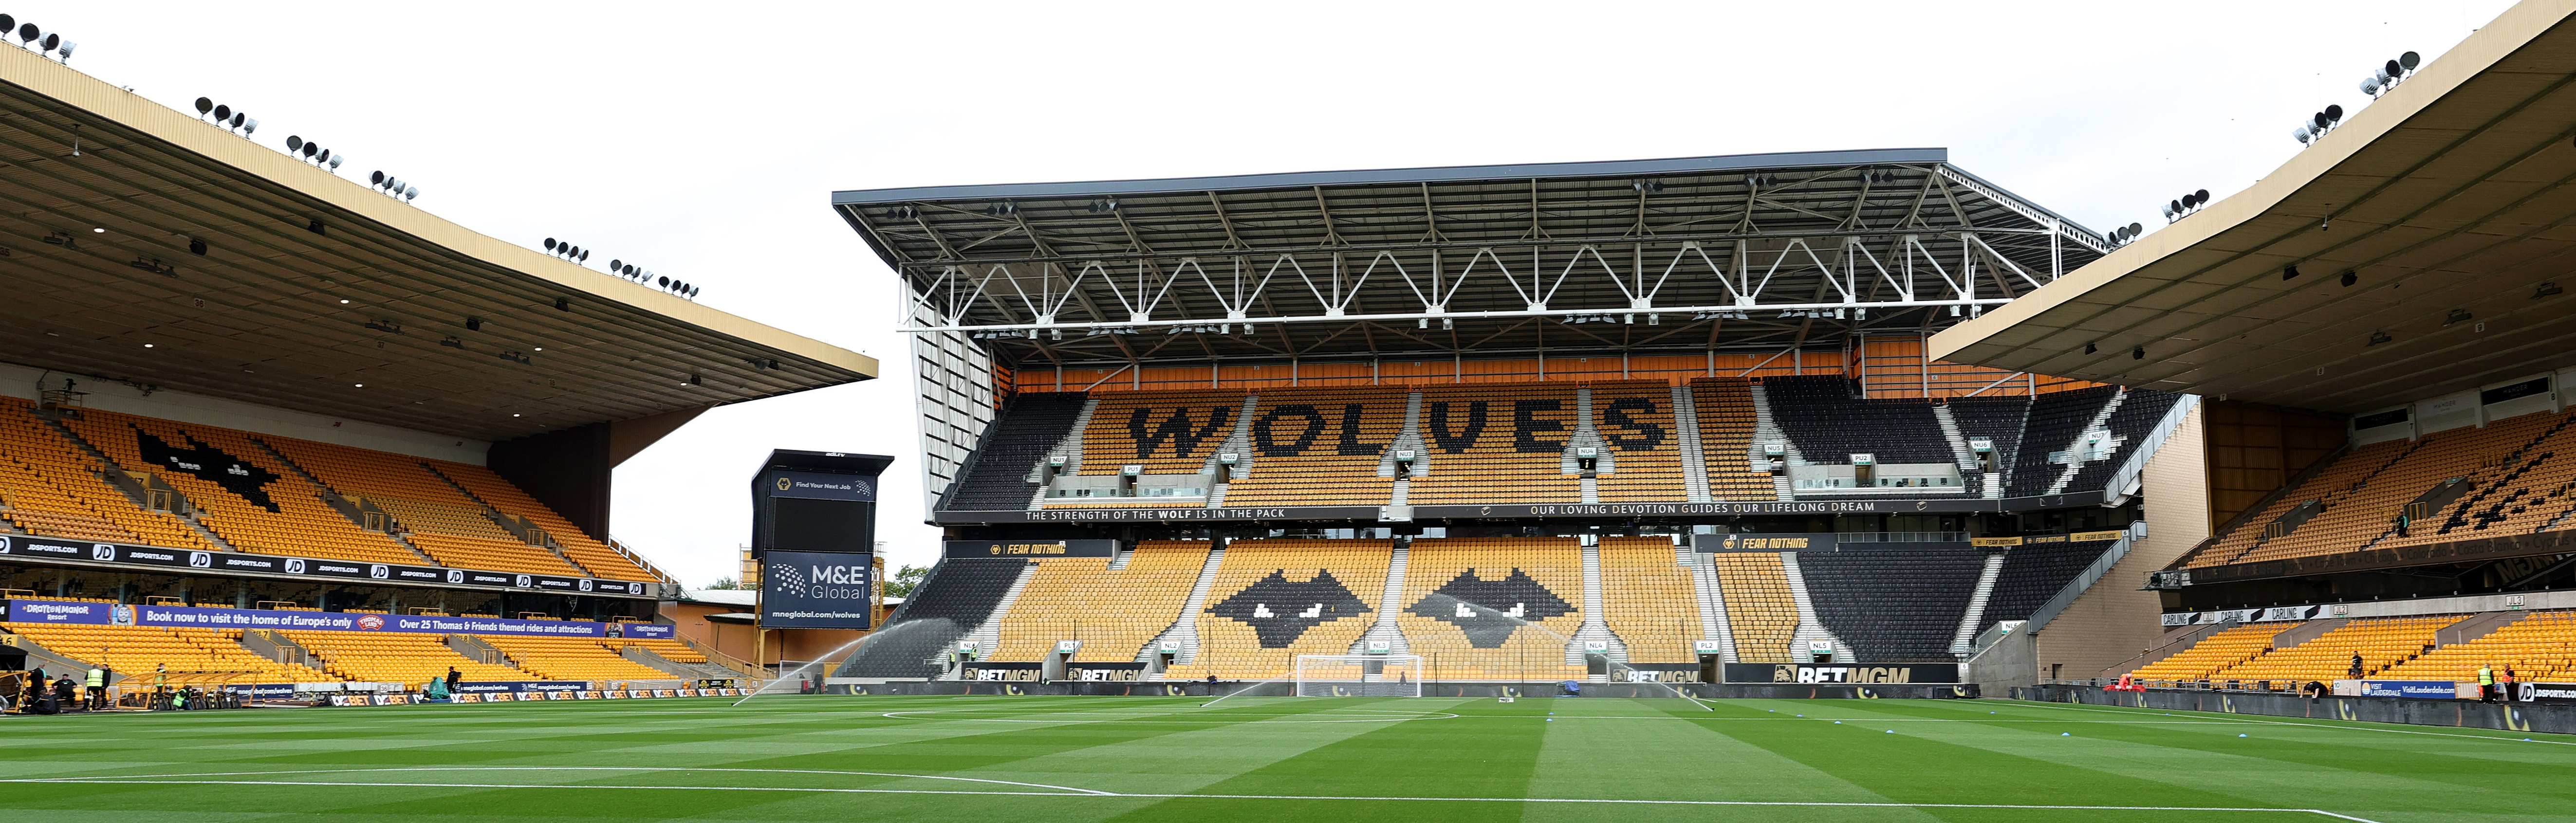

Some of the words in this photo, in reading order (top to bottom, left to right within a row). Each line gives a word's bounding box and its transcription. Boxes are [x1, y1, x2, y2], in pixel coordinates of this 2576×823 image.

[195, 299, 204, 308] 36
[1127, 397, 1665, 458] WOLVES
[1531, 506, 1555, 514] OUR
[1561, 505, 1607, 514] LOVING
[1612, 505, 1676, 514] DEVOTION
[1681, 504, 1728, 513] GUIDES
[1734, 504, 1759, 512] OUR
[1765, 503, 1825, 512] LIFELONG
[1832, 502, 1874, 512] DREAM
[1026, 512, 1046, 520] THE
[1051, 511, 1108, 520] STRENGTH
[1113, 511, 1127, 519] OF
[1132, 511, 1153, 519] THE
[1158, 511, 1191, 519] WOLF
[1197, 510, 1207, 518] IS
[1230, 510, 1251, 518] THE
[1257, 509, 1284, 517] PACK
[27, 544, 77, 553] JDSPORTS.COM
[1742, 538, 1767, 549] FEAR
[1769, 538, 1809, 548] NOTHING
[2533, 536, 2570, 550] Cyprus
[96, 546, 111, 558] JD
[1007, 545, 1029, 554] FEAR
[1030, 544, 1066, 554] NOTHING
[2407, 549, 2446, 559] Colorado
[2457, 544, 2484, 555] Costa
[130, 552, 173, 561] JDSPORTS.COM
[194, 553, 208, 566] JD
[2365, 551, 2397, 566] Chicago
[226, 559, 271, 568] JDSPORTS.COM
[288, 561, 301, 572] JD
[373, 567, 385, 577] JD
[450, 572, 461, 582] JD
[812, 565, 865, 585] M&E
[519, 577, 529, 586] JD
[581, 581, 590, 590] JD
[630, 585, 640, 593] JD
[812, 585, 864, 599] Global
[2508, 596, 2522, 605] JL3
[772, 611, 860, 619] mneglobal.com/wolves
[2164, 614, 2187, 624] CARLING
[2221, 611, 2243, 622] CARLING
[2272, 608, 2297, 620] CARLING
[147, 611, 171, 622] Book
[174, 614, 196, 622] now
[198, 613, 208, 623] to
[210, 613, 230, 623] visit
[233, 614, 250, 624] the
[252, 614, 278, 625] home
[281, 615, 291, 625] of
[293, 615, 331, 628] Europe's
[333, 617, 352, 629] only
[358, 616, 384, 625] THOMAS
[400, 619, 419, 629] Over
[421, 620, 430, 629] 25
[433, 620, 463, 630] Thomas
[464, 622, 470, 630] &
[471, 622, 497, 631] Friends
[499, 622, 525, 632] themed
[527, 623, 543, 632] rides
[544, 624, 557, 633] and
[558, 625, 593, 634] attractions
[978, 669, 1040, 681] BETMGM
[1081, 669, 1142, 681] BETMGM
[1627, 670, 1698, 683] BETMGM
[1798, 667, 1910, 683] BETMGM
[2521, 685, 2532, 700] JD
[2535, 689, 2576, 698] JDSPORTS.CO
